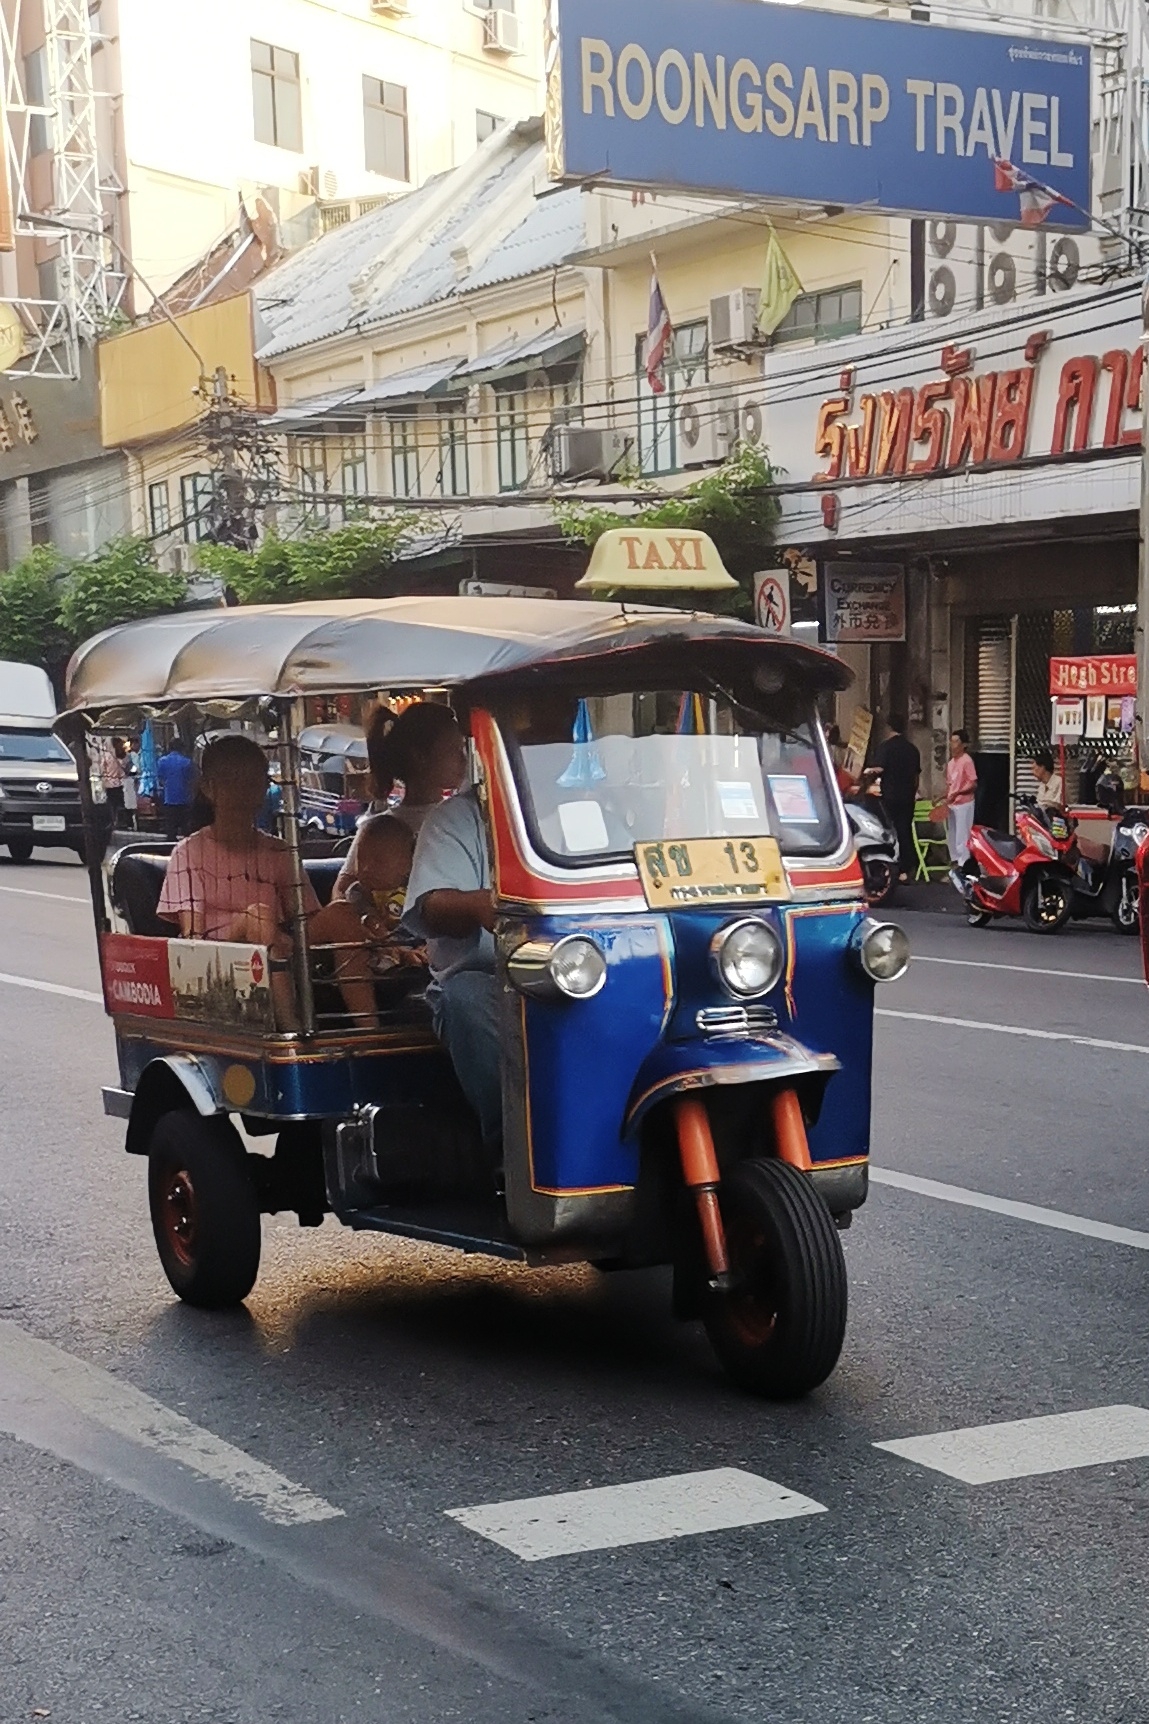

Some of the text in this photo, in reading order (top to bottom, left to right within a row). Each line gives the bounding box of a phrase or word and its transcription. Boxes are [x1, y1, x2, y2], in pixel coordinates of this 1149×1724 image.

[580, 37, 1074, 168] ROONGSARP TRAVEL
[812, 330, 1049, 529] รุ่งทรัพย์
[618, 536, 708, 571] TAXI
[831, 578, 897, 593] CURRENCY
[723, 841, 760, 874] 13
[112, 979, 162, 1006] CAMBODIA
